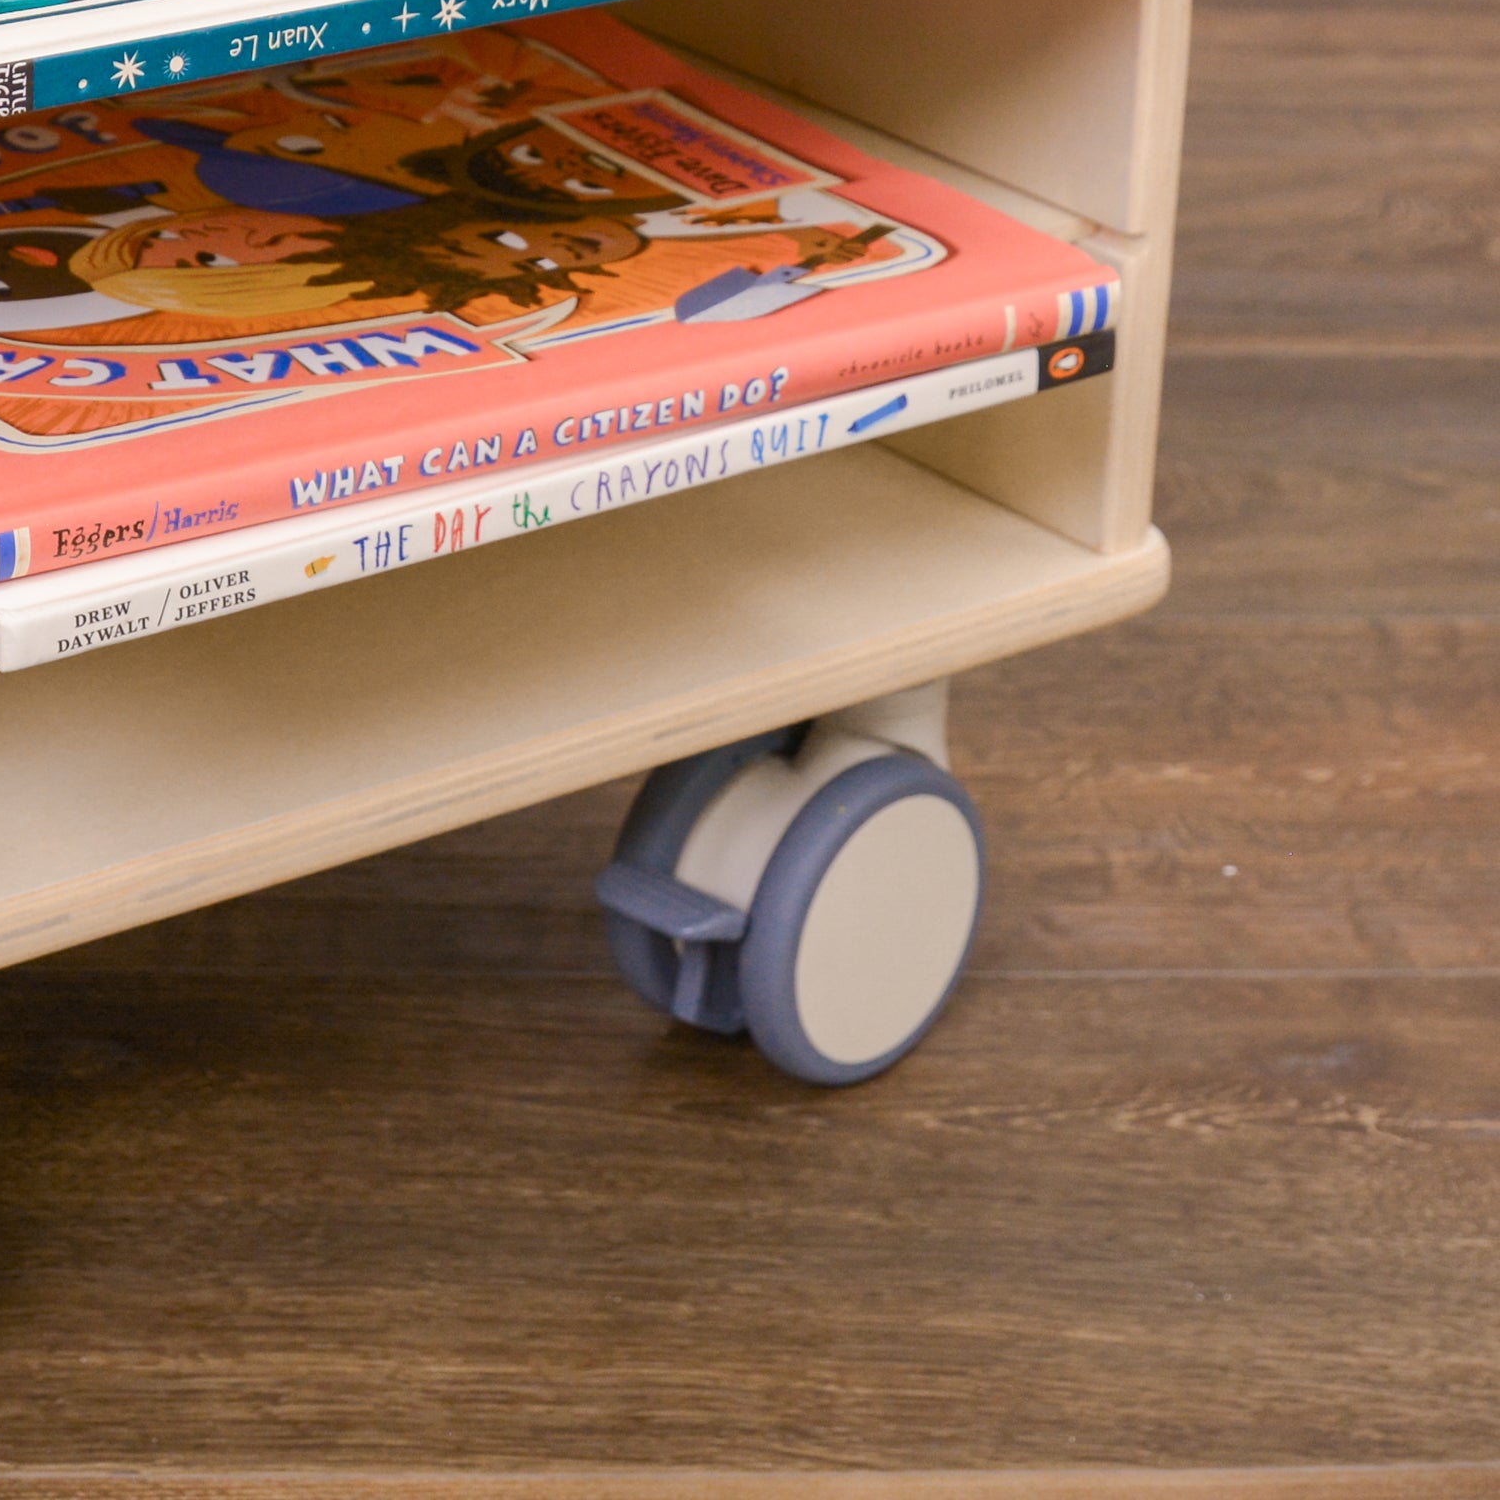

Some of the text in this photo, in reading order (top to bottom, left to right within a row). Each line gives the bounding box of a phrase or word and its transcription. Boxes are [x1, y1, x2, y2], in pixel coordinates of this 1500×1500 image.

[229, 20, 329, 63] Xuan Le
[150, 327, 481, 391] WHAT
[934, 334, 984, 357] books
[949, 369, 1025, 400] PHILOMEL
[289, 366, 790, 509] WHAT CAN A CITIZEN DO?
[352, 413, 831, 572] THE DAY the CRAYONS QUIT
[179, 570, 251, 600] OLIVER
[74, 600, 132, 629] DREW
[175, 588, 257, 622] JEFFERS
[57, 616, 150, 654] DAYWALT
